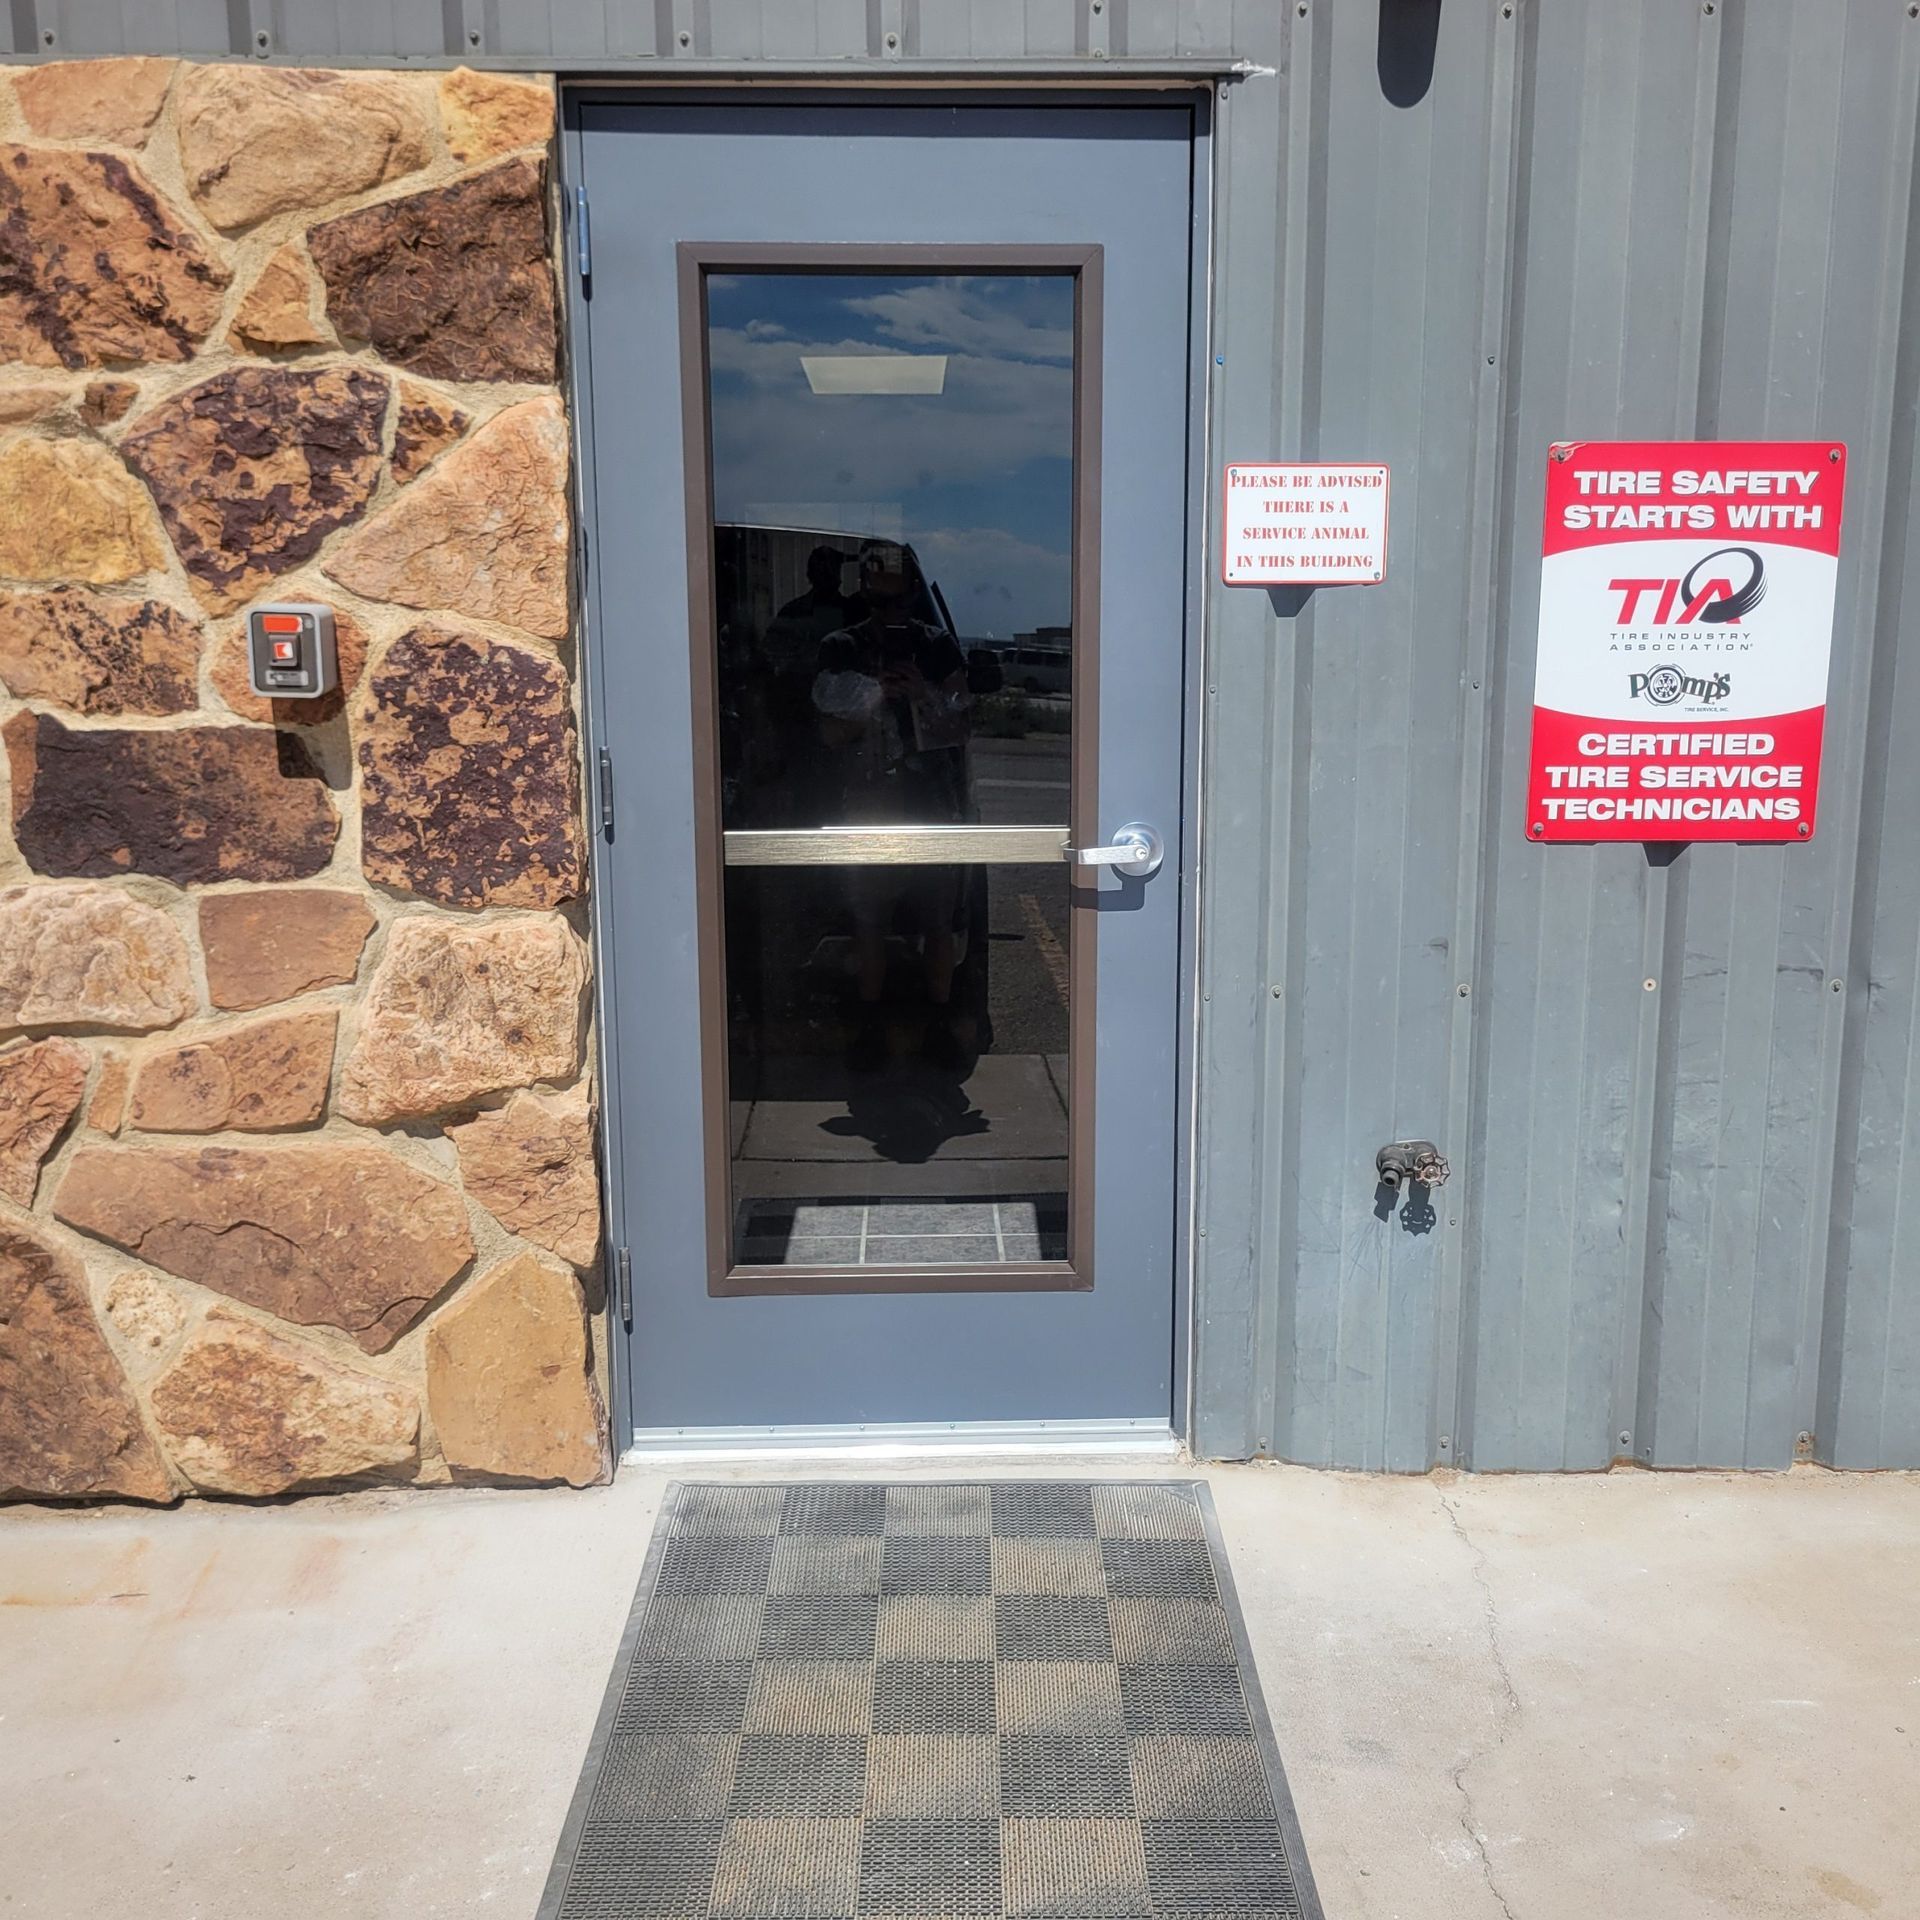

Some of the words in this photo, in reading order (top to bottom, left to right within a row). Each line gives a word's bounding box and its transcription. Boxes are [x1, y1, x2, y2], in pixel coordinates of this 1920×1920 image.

[1231, 475, 1287, 487] PLEASE
[1293, 476, 1312, 487] BE
[1317, 476, 1382, 487] ADVISED
[1573, 471, 1661, 494] TIRE
[1671, 471, 1819, 495] SAFETY
[1263, 501, 1314, 512] THERE
[1320, 501, 1334, 512] IS
[1340, 501, 1349, 512] A
[1563, 505, 1715, 529] STARTS
[1727, 505, 1822, 529] WITH
[1242, 527, 1306, 539] SERVICE
[1311, 527, 1369, 539] ANIMAL
[1237, 555, 1253, 567] IN
[1258, 555, 1295, 567] THIS
[1300, 555, 1373, 567] BUILDING
[1608, 578, 1742, 625] TIA
[1609, 643, 1749, 651] ASSOCIATION
[1578, 733, 1775, 756] CERTIFIED
[1545, 766, 1630, 788] TIRE
[1639, 766, 1803, 788] SERVICE
[1542, 798, 1800, 820] TECHNICIANS
